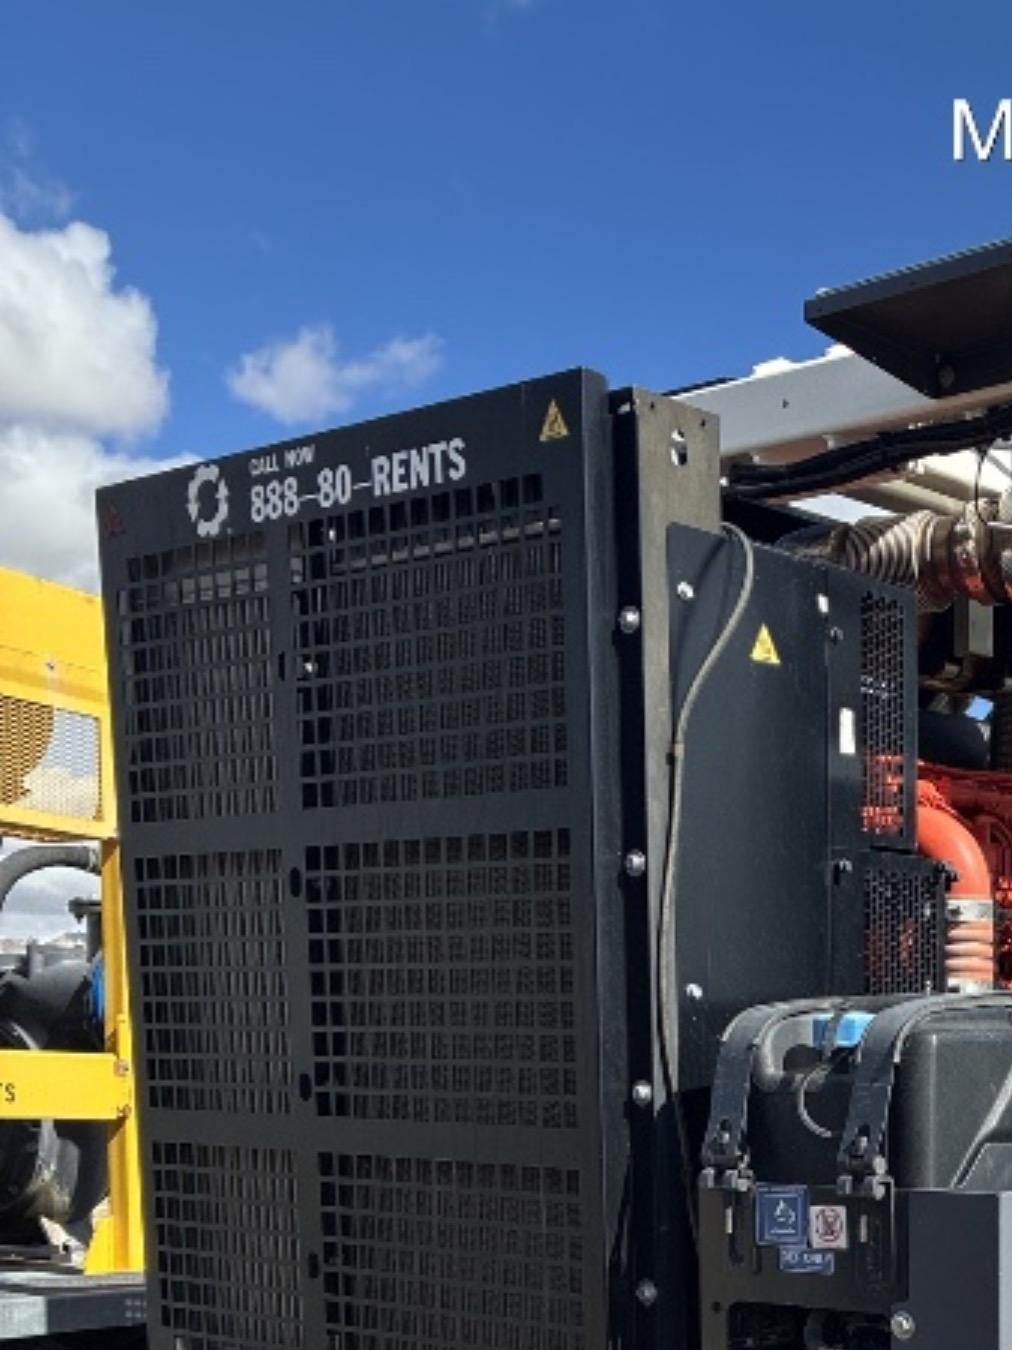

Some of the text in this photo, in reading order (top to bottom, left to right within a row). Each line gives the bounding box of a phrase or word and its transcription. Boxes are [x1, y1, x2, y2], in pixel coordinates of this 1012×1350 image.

[249, 444, 316, 476] CALL NOW
[250, 437, 466, 524] 888-80-RENTS
